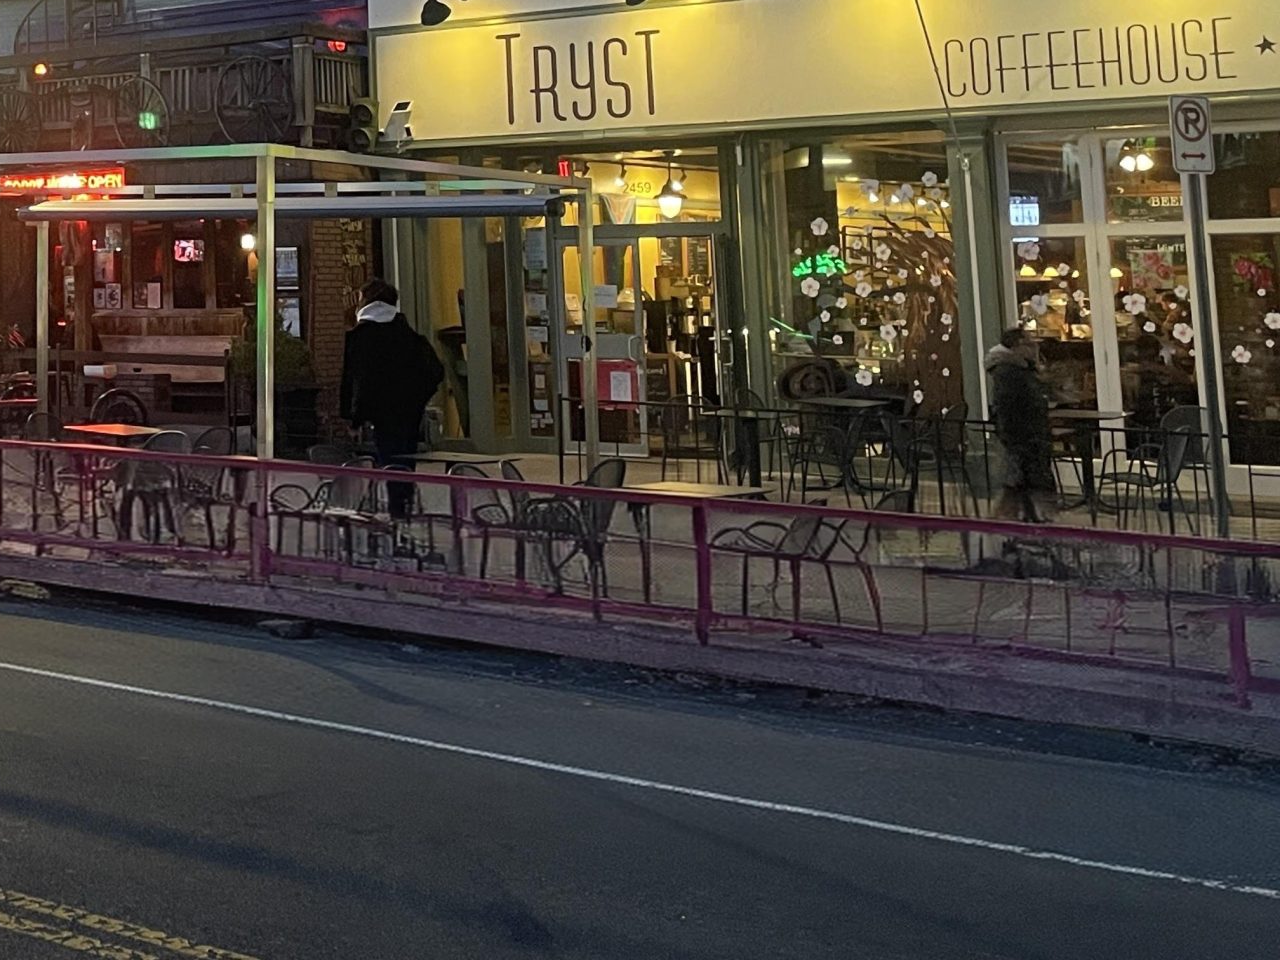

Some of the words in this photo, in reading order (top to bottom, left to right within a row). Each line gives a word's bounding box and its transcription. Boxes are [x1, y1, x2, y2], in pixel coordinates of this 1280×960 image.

[495, 29, 661, 126] TRYST
[944, 16, 1238, 98] COFFEEHOUSE
[87, 173, 122, 189] OPEN
[623, 181, 652, 194] 2459
